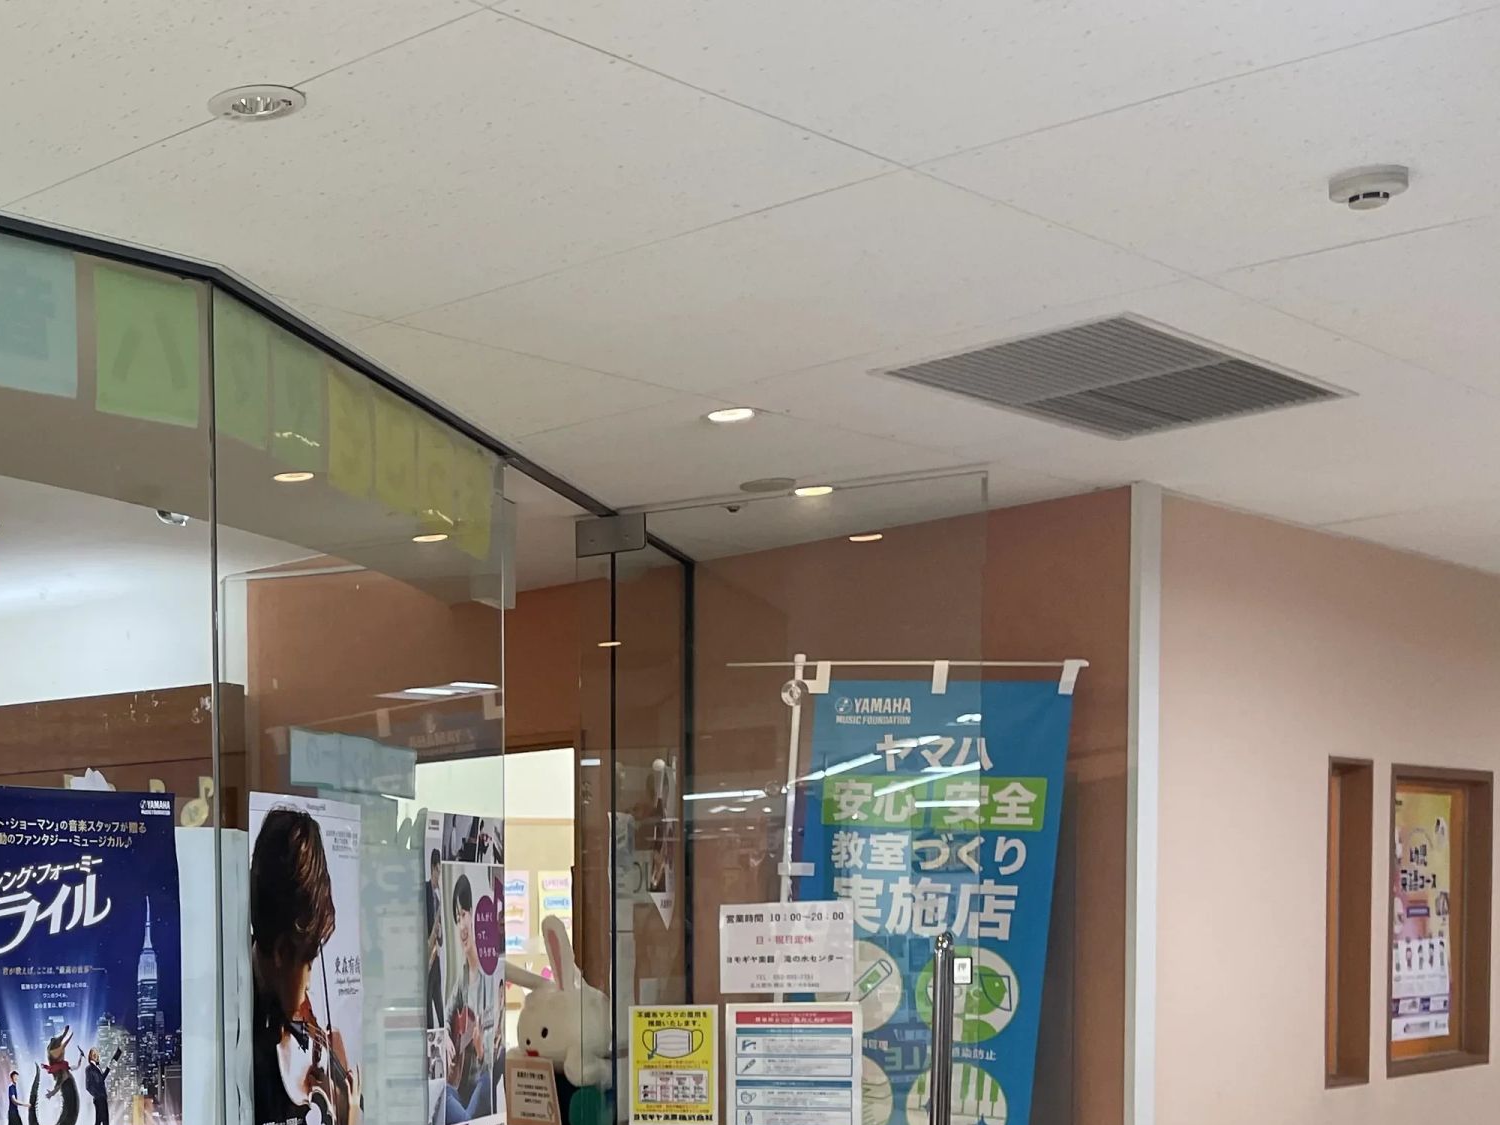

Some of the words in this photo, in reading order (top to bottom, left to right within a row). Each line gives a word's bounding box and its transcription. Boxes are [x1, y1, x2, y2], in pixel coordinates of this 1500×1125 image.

[854, 698, 911, 713] YAMAHA
[876, 734, 993, 771] ヤマハ
[832, 779, 918, 823] 安心
[943, 781, 1037, 826] 安全
[831, 831, 1027, 876] 教室づくり
[833, 874, 1018, 941] 実施店
